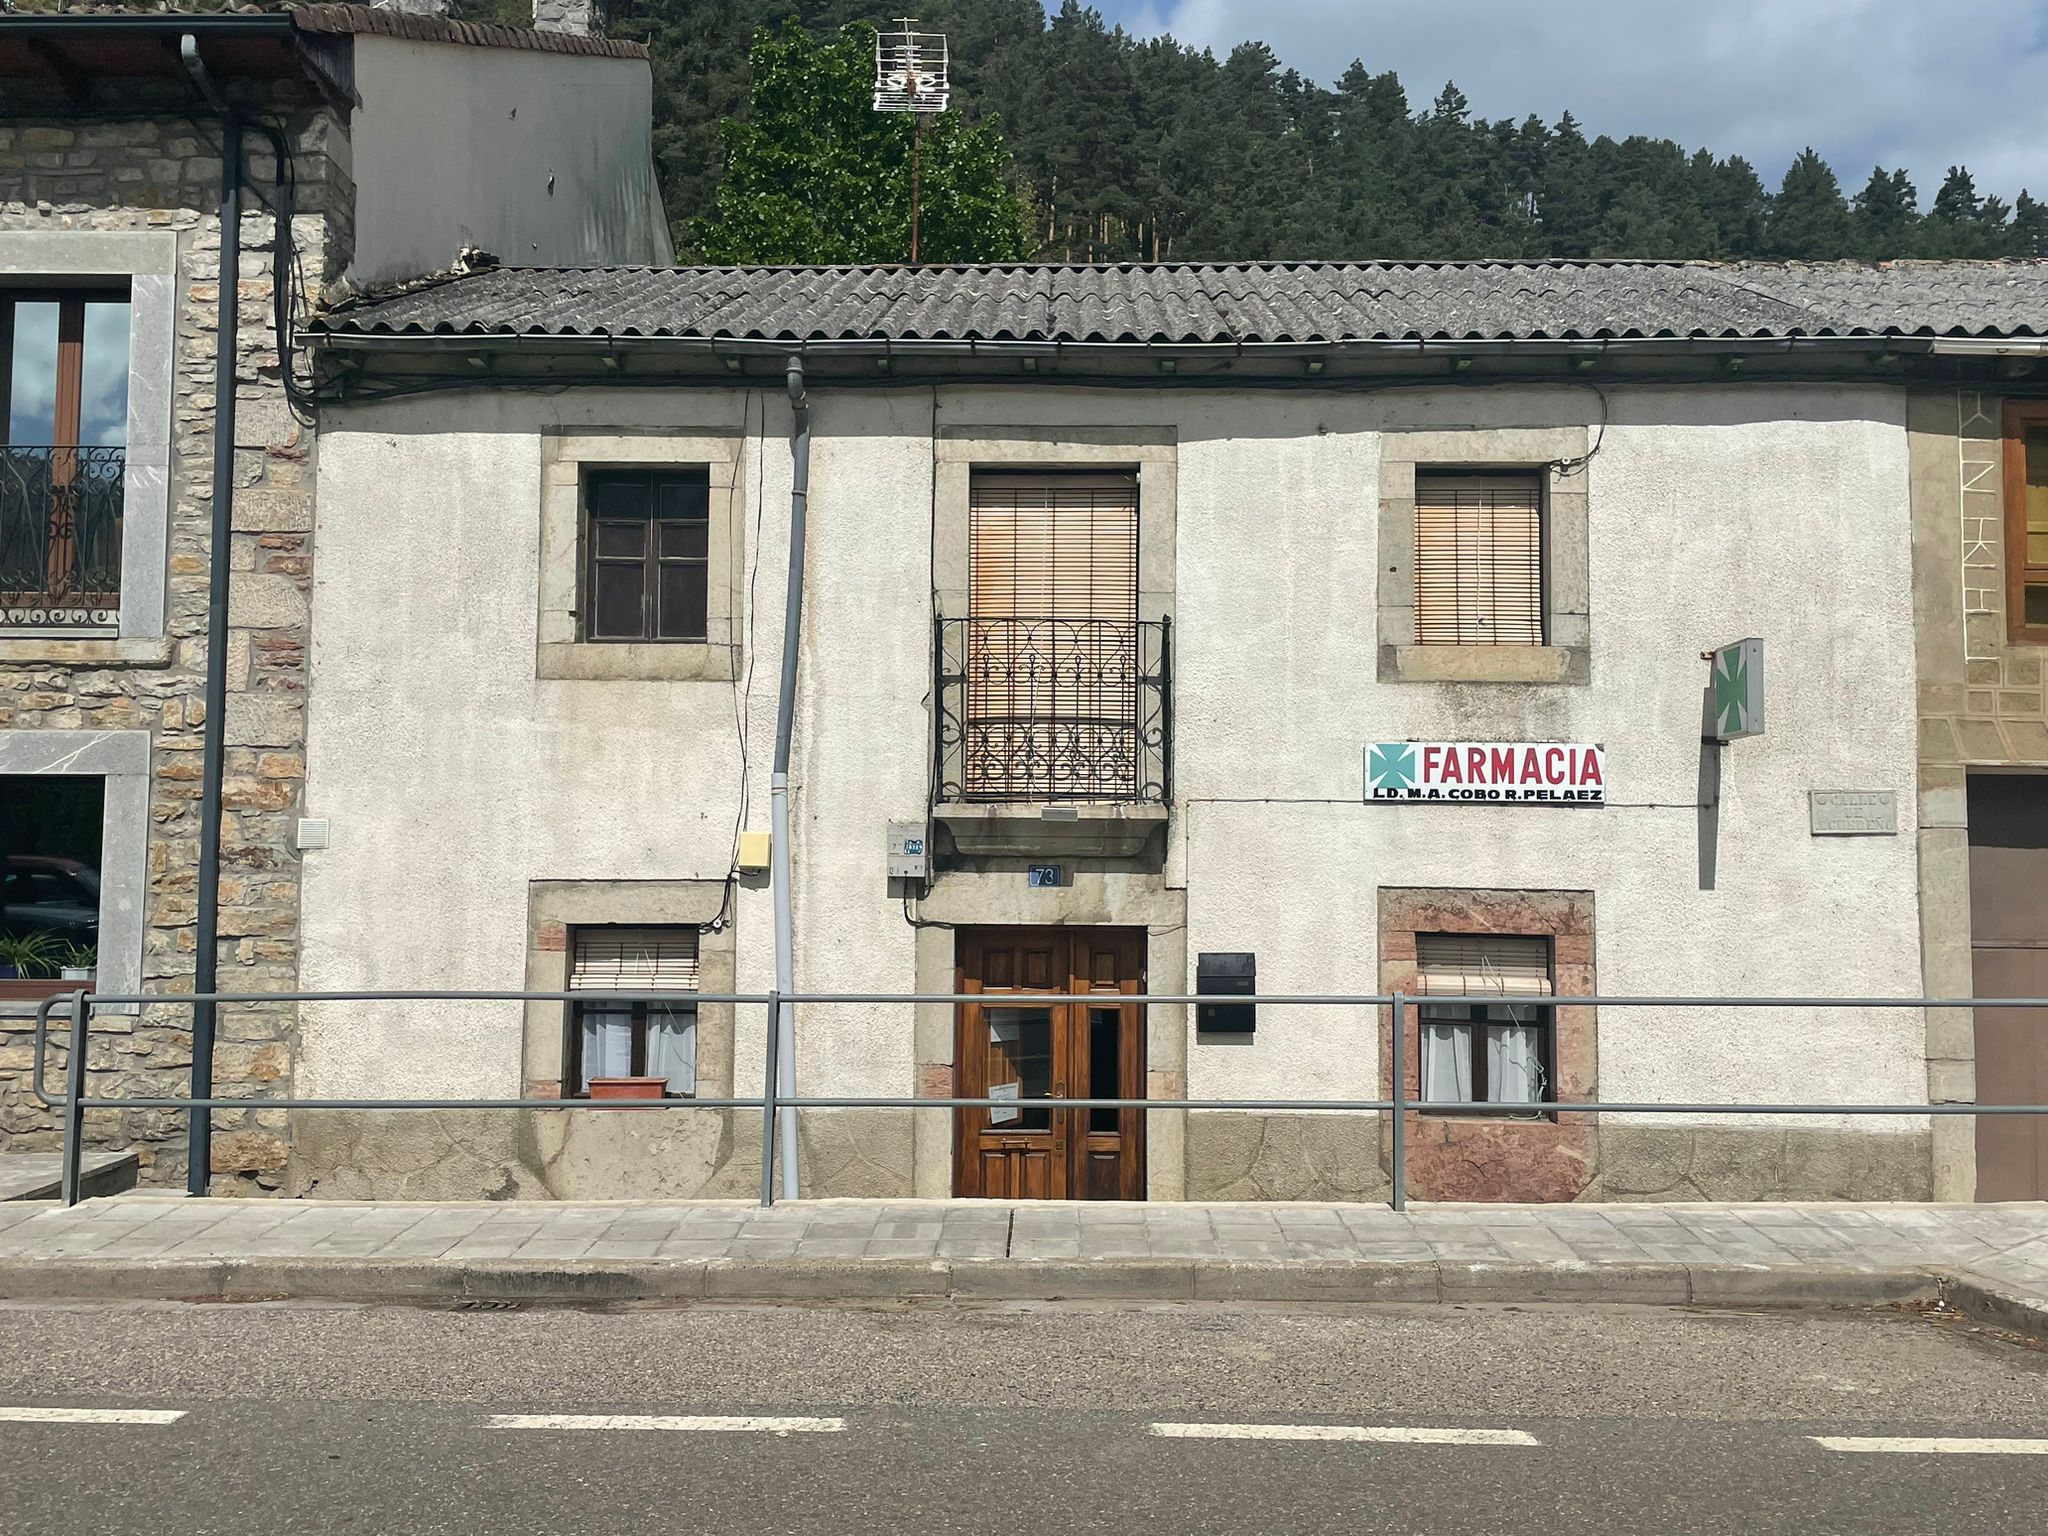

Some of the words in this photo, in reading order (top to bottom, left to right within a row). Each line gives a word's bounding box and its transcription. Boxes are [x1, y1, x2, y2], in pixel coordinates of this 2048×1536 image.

[1424, 747, 1602, 785] FARMACIA
[1448, 789, 1500, 800] COBO
[1035, 868, 1054, 886] 73
